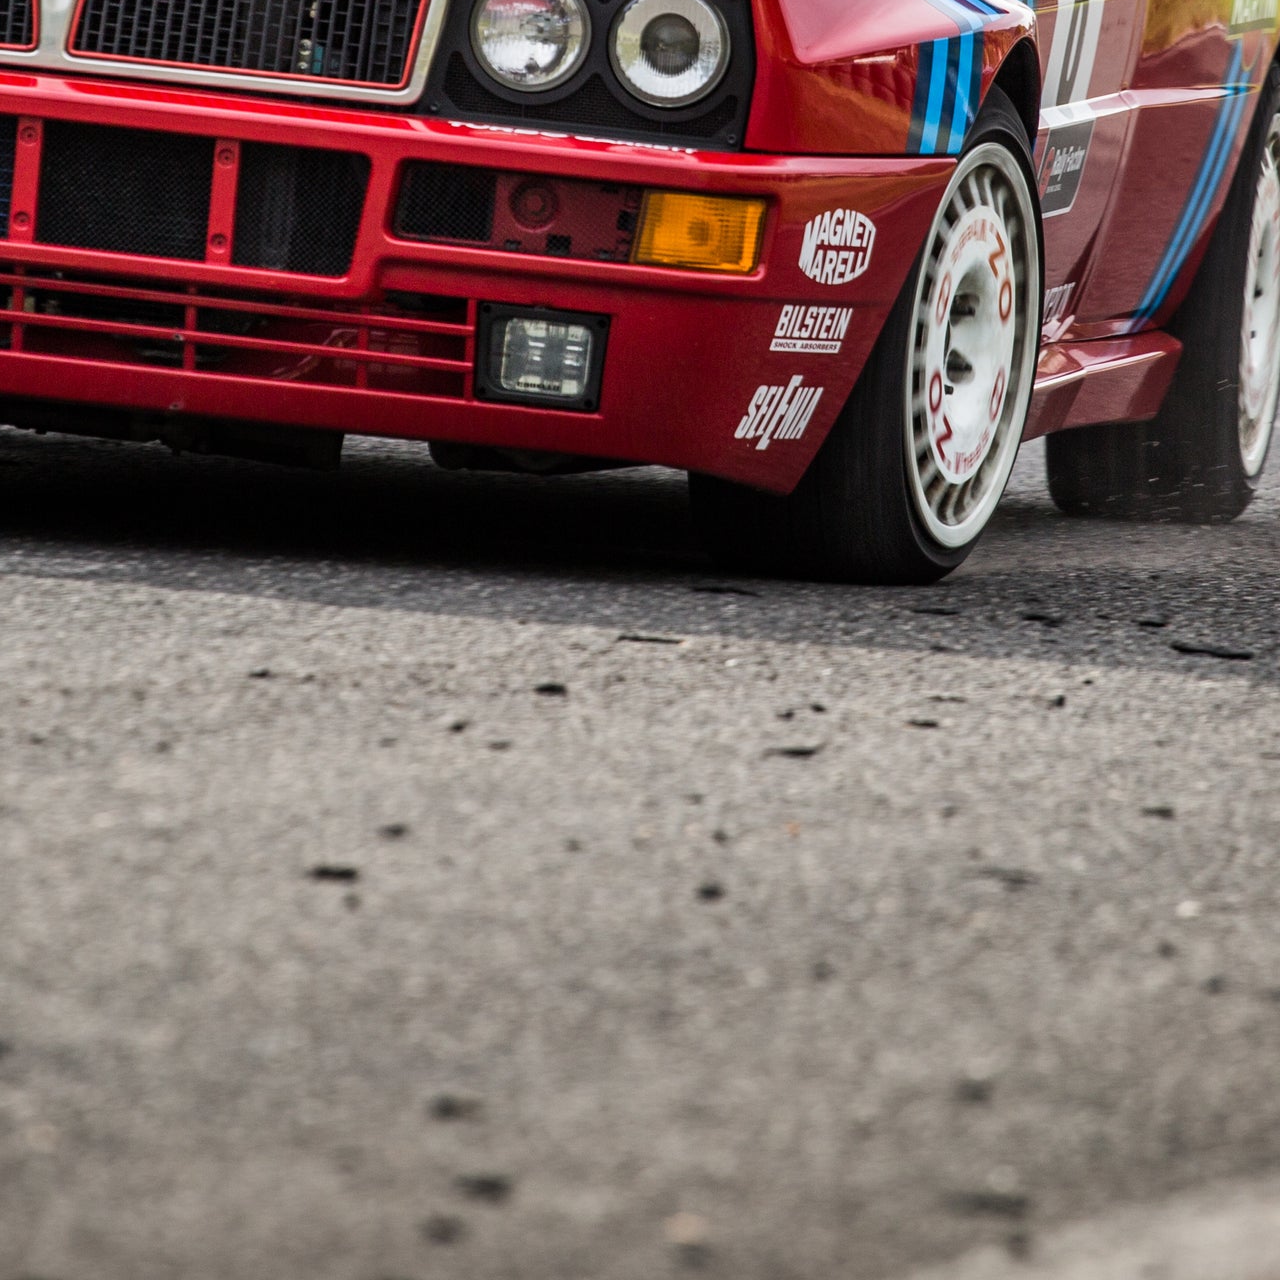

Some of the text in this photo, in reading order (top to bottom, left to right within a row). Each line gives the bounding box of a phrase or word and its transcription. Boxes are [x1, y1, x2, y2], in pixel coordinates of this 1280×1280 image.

[774, 304, 853, 339] BILSTEIN
[773, 341, 838, 351] SHOCK ABSORBERS
[734, 374, 824, 451] SELENIA
